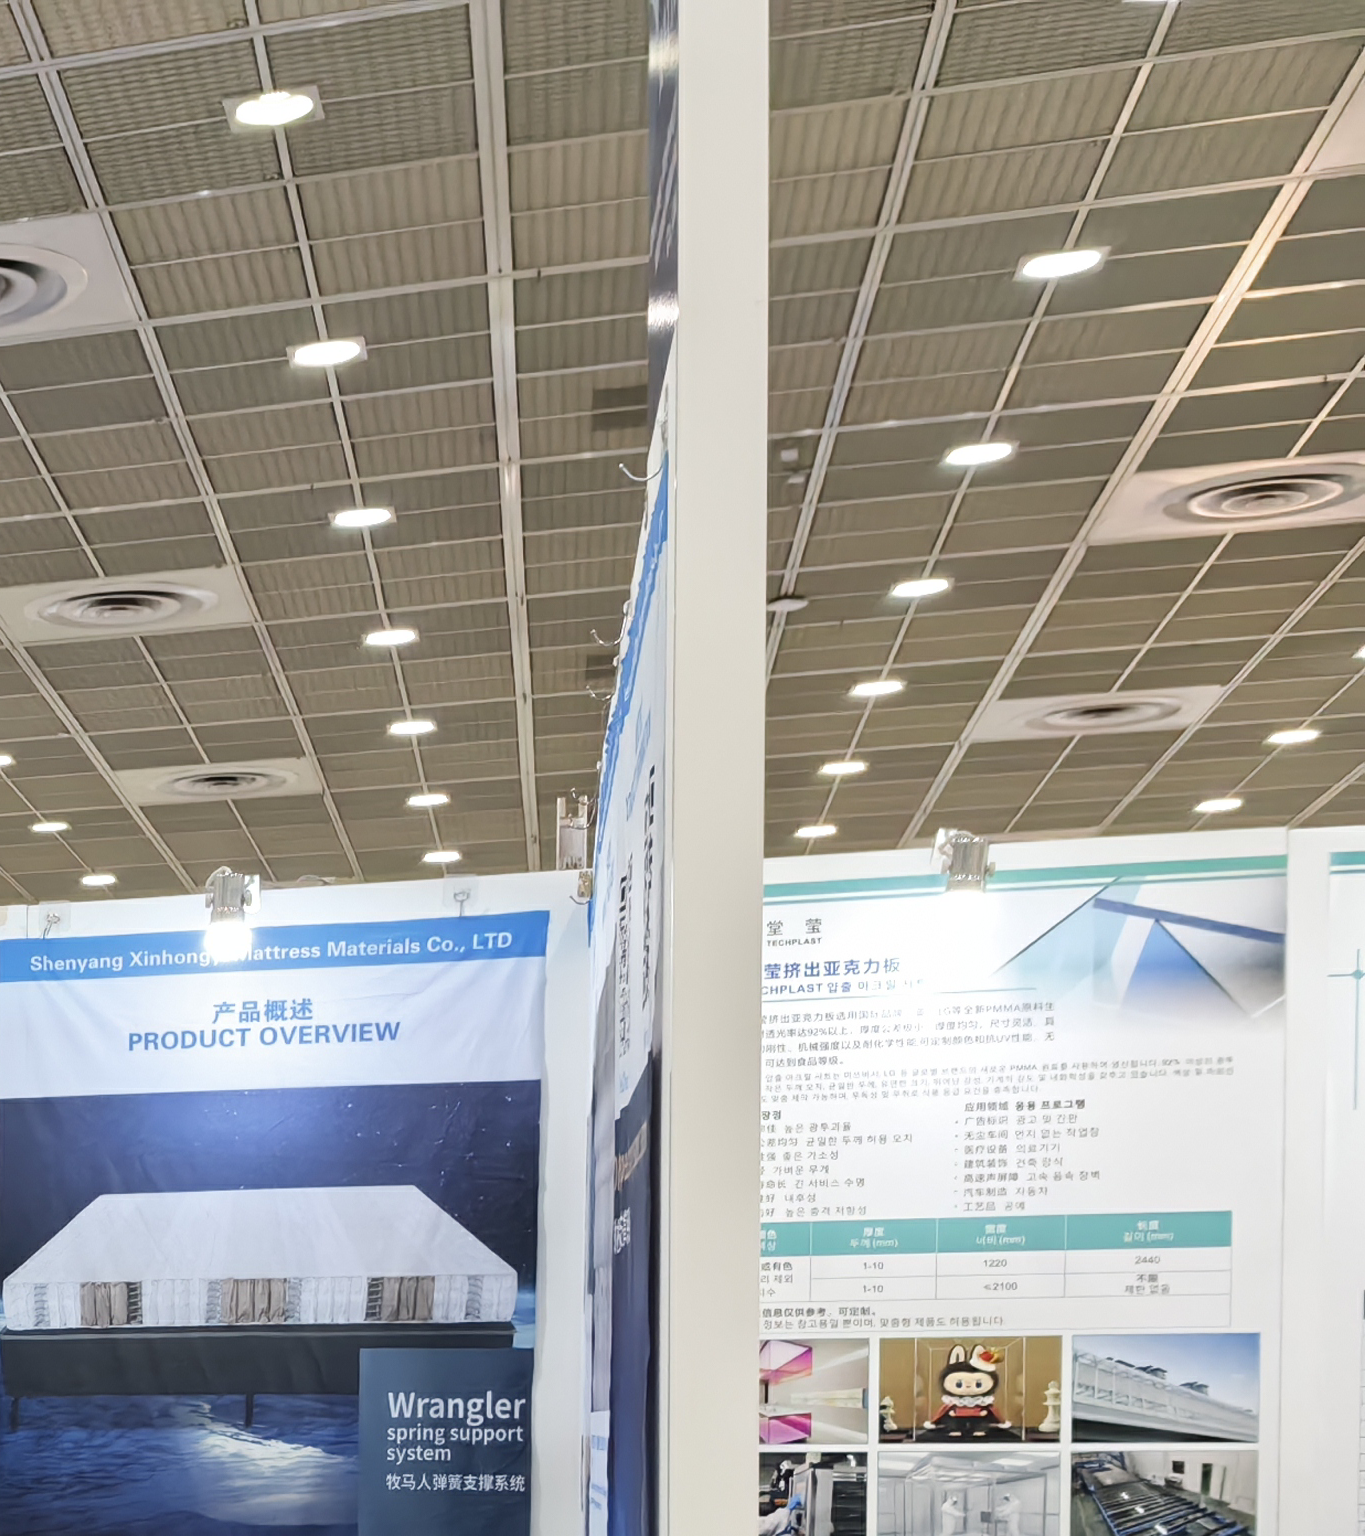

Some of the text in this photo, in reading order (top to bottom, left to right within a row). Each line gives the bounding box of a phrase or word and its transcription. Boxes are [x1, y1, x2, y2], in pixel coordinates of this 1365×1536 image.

[30, 953, 124, 973] Shenyang
[327, 937, 421, 958] Materials
[472, 931, 512, 952] LTD
[767, 938, 822, 947] TECHPLAST
[211, 998, 314, 1024] 产品概述
[128, 1021, 400, 1052] PRODUCT OVERVIEW
[984, 1258, 1007, 1268] 1220
[1134, 1255, 1161, 1264] 2440
[388, 1390, 526, 1426] Wrangler
[387, 1423, 523, 1445] spring support
[386, 1445, 451, 1465] system
[386, 1473, 525, 1492] 牧马人弹簧支撑系统
